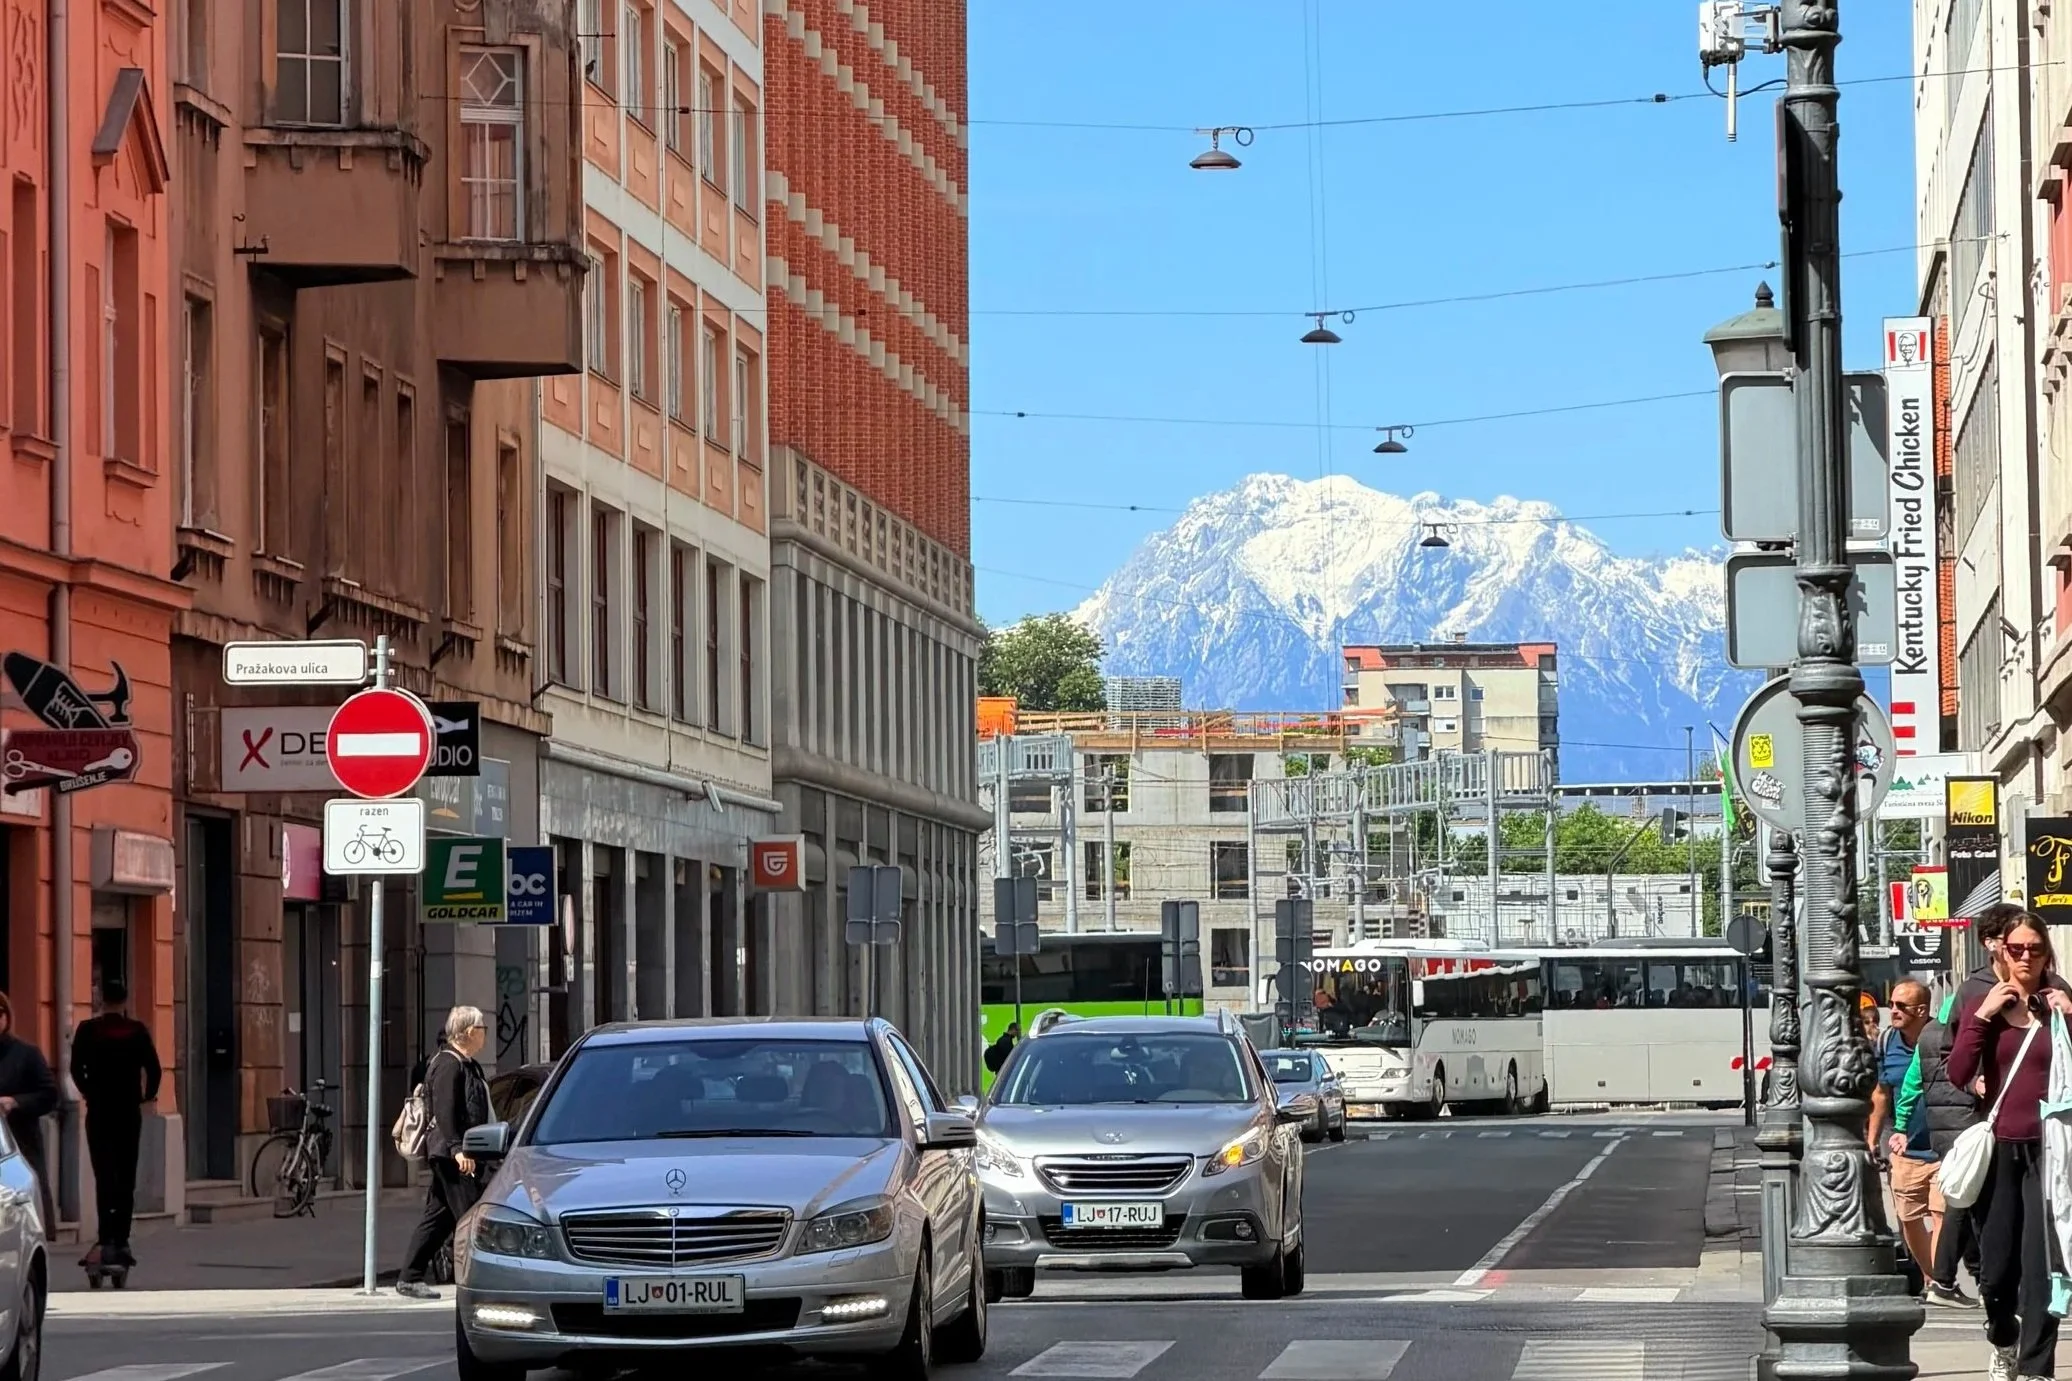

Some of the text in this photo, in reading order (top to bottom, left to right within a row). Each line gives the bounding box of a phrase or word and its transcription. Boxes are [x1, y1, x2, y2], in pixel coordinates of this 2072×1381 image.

[1891, 397, 1930, 675] Kentucky Fried Chicken
[236, 662, 328, 675] Pražakova ulica
[359, 807, 389, 816] razen
[1951, 811, 1993, 824] Nikon
[1950, 850, 1972, 859] Foto
[427, 907, 499, 919] GOLDCAR
[1077, 1206, 1157, 1223] LJ 17-RUJ
[625, 1281, 733, 1304] LJ 01-RUL
